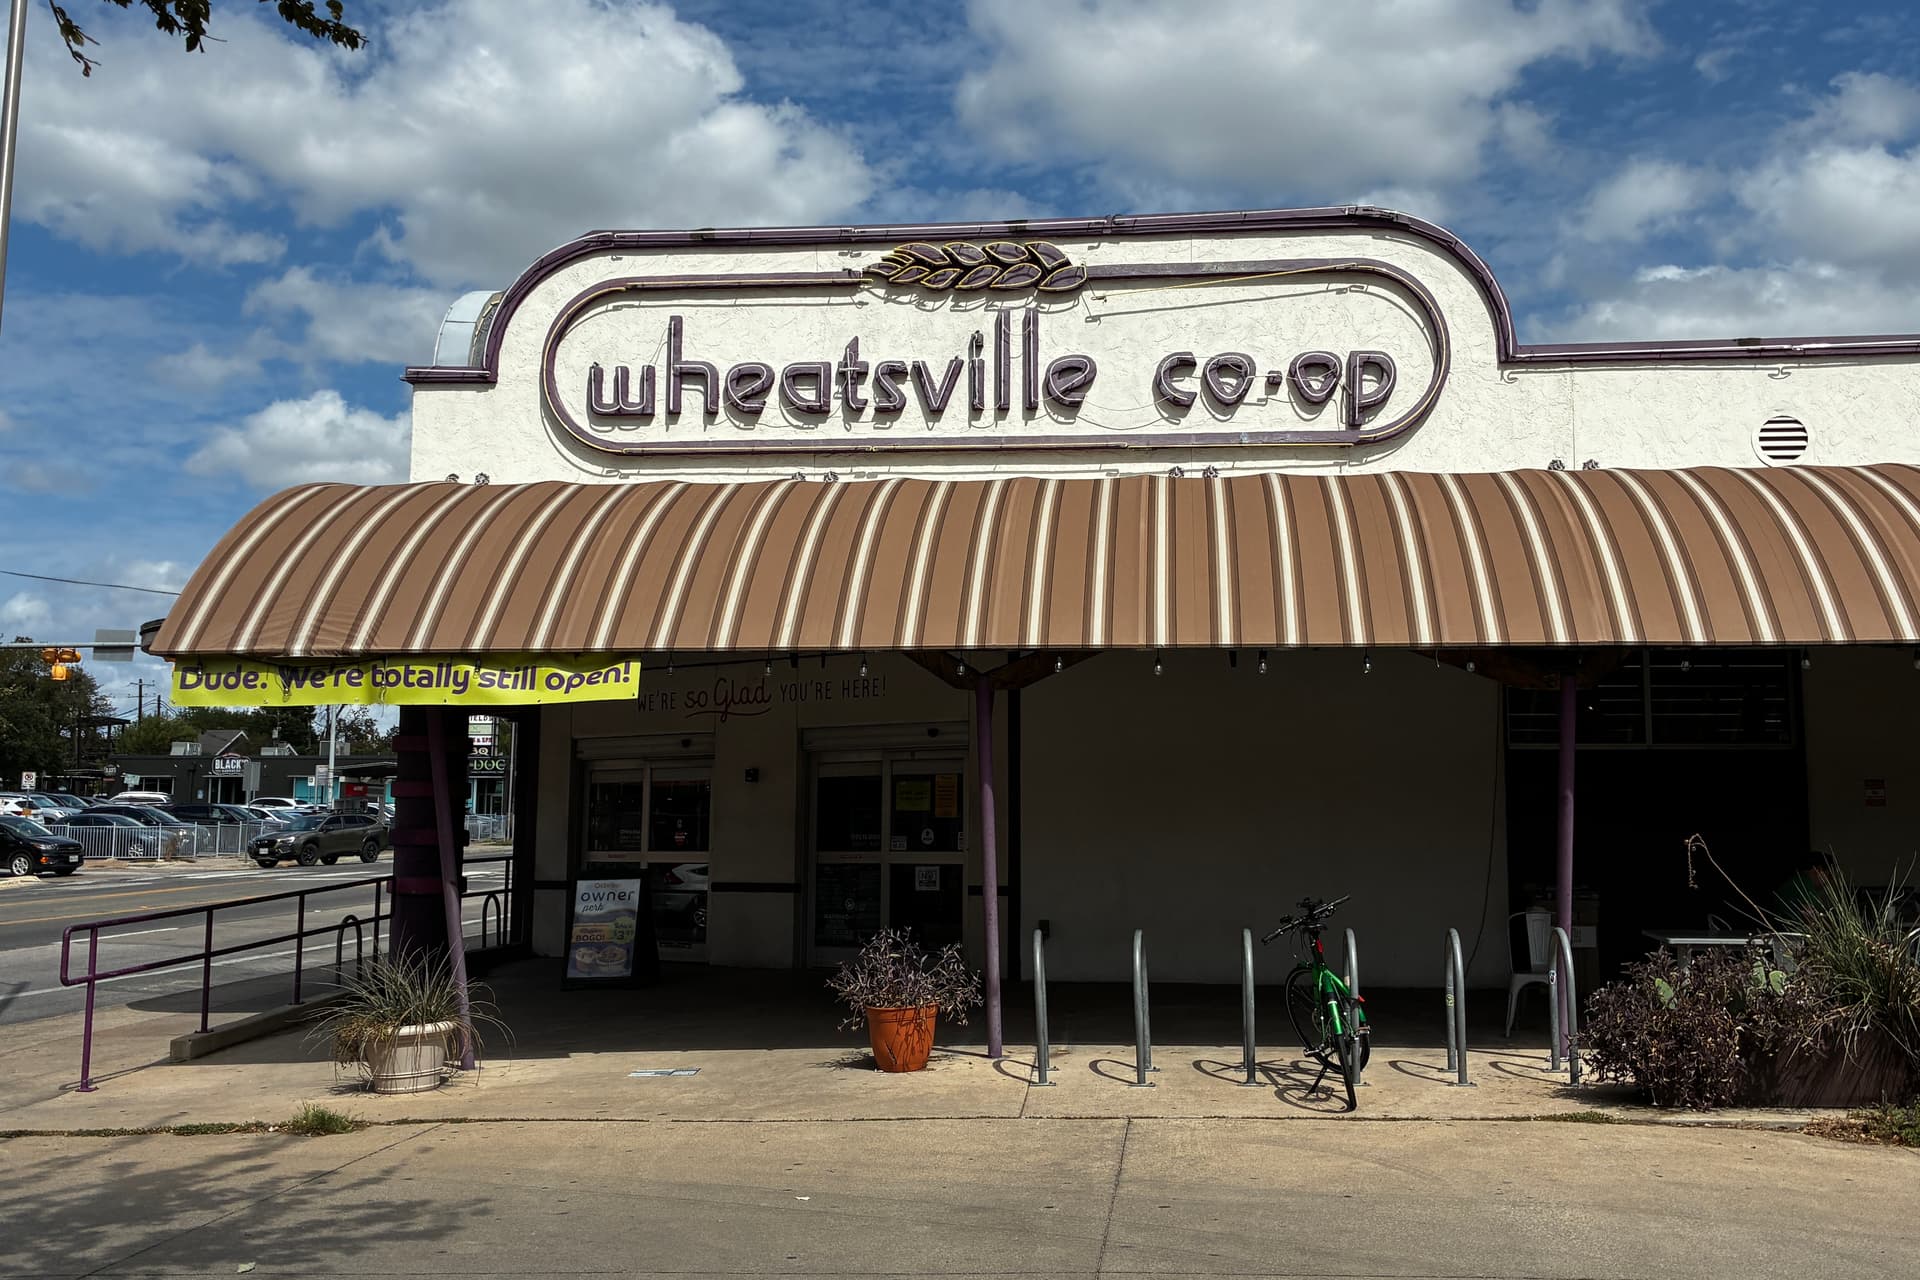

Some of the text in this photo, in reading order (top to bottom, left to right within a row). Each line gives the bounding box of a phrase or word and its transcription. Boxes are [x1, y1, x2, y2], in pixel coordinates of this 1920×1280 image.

[590, 310, 1097, 418] wheatsville
[179, 660, 631, 695] Dude. We're totally still open!
[638, 675, 887, 722] WE'RE so Glad YOU'RE HERE!
[581, 890, 635, 902] owner
